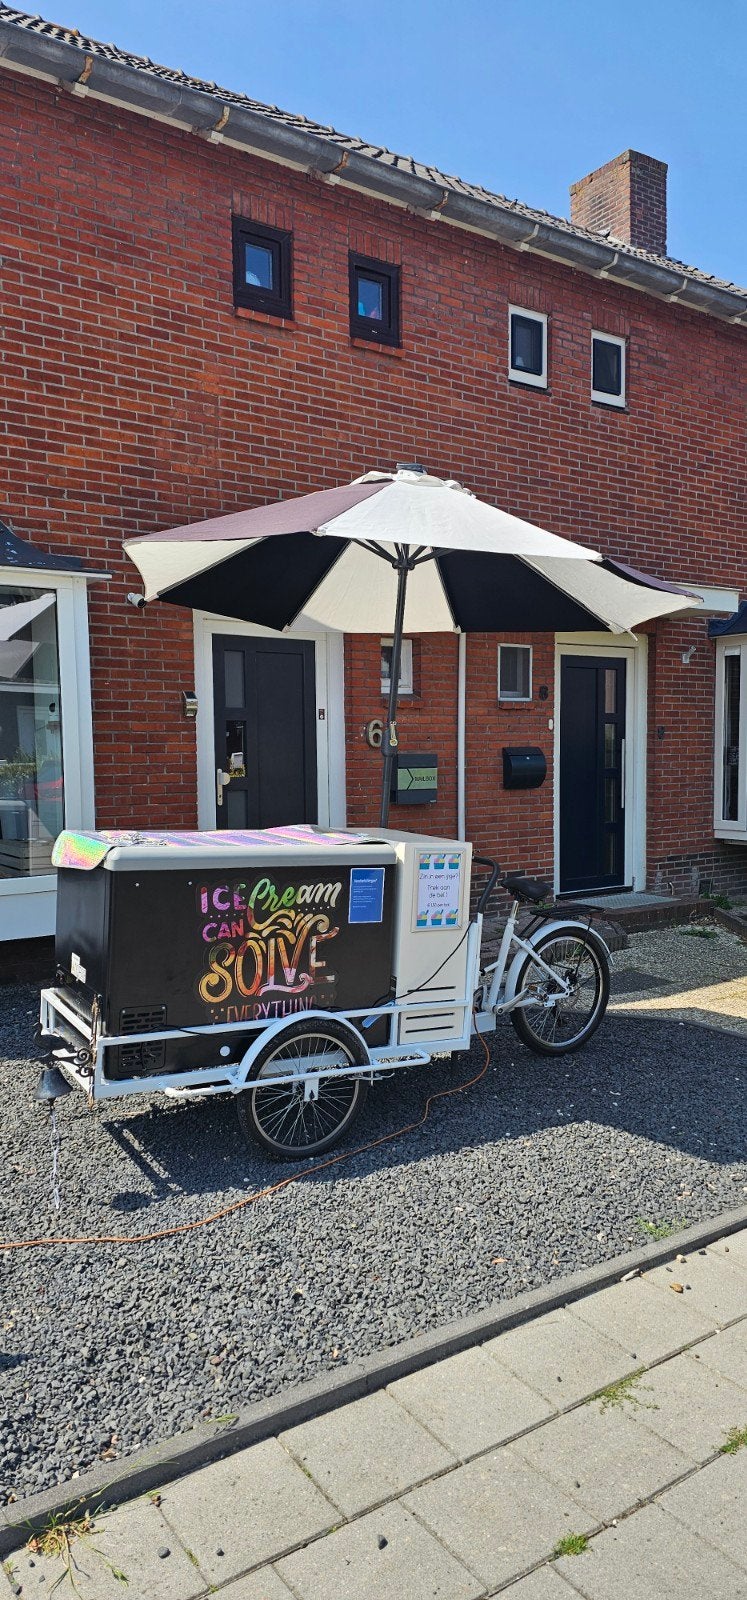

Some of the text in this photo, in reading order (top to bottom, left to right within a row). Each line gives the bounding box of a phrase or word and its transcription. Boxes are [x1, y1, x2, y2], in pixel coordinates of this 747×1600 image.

[367, 719, 383, 747] 6
[201, 878, 342, 922] ICE Cream
[202, 919, 244, 942] CAN
[199, 920, 340, 1003] SOLVE
